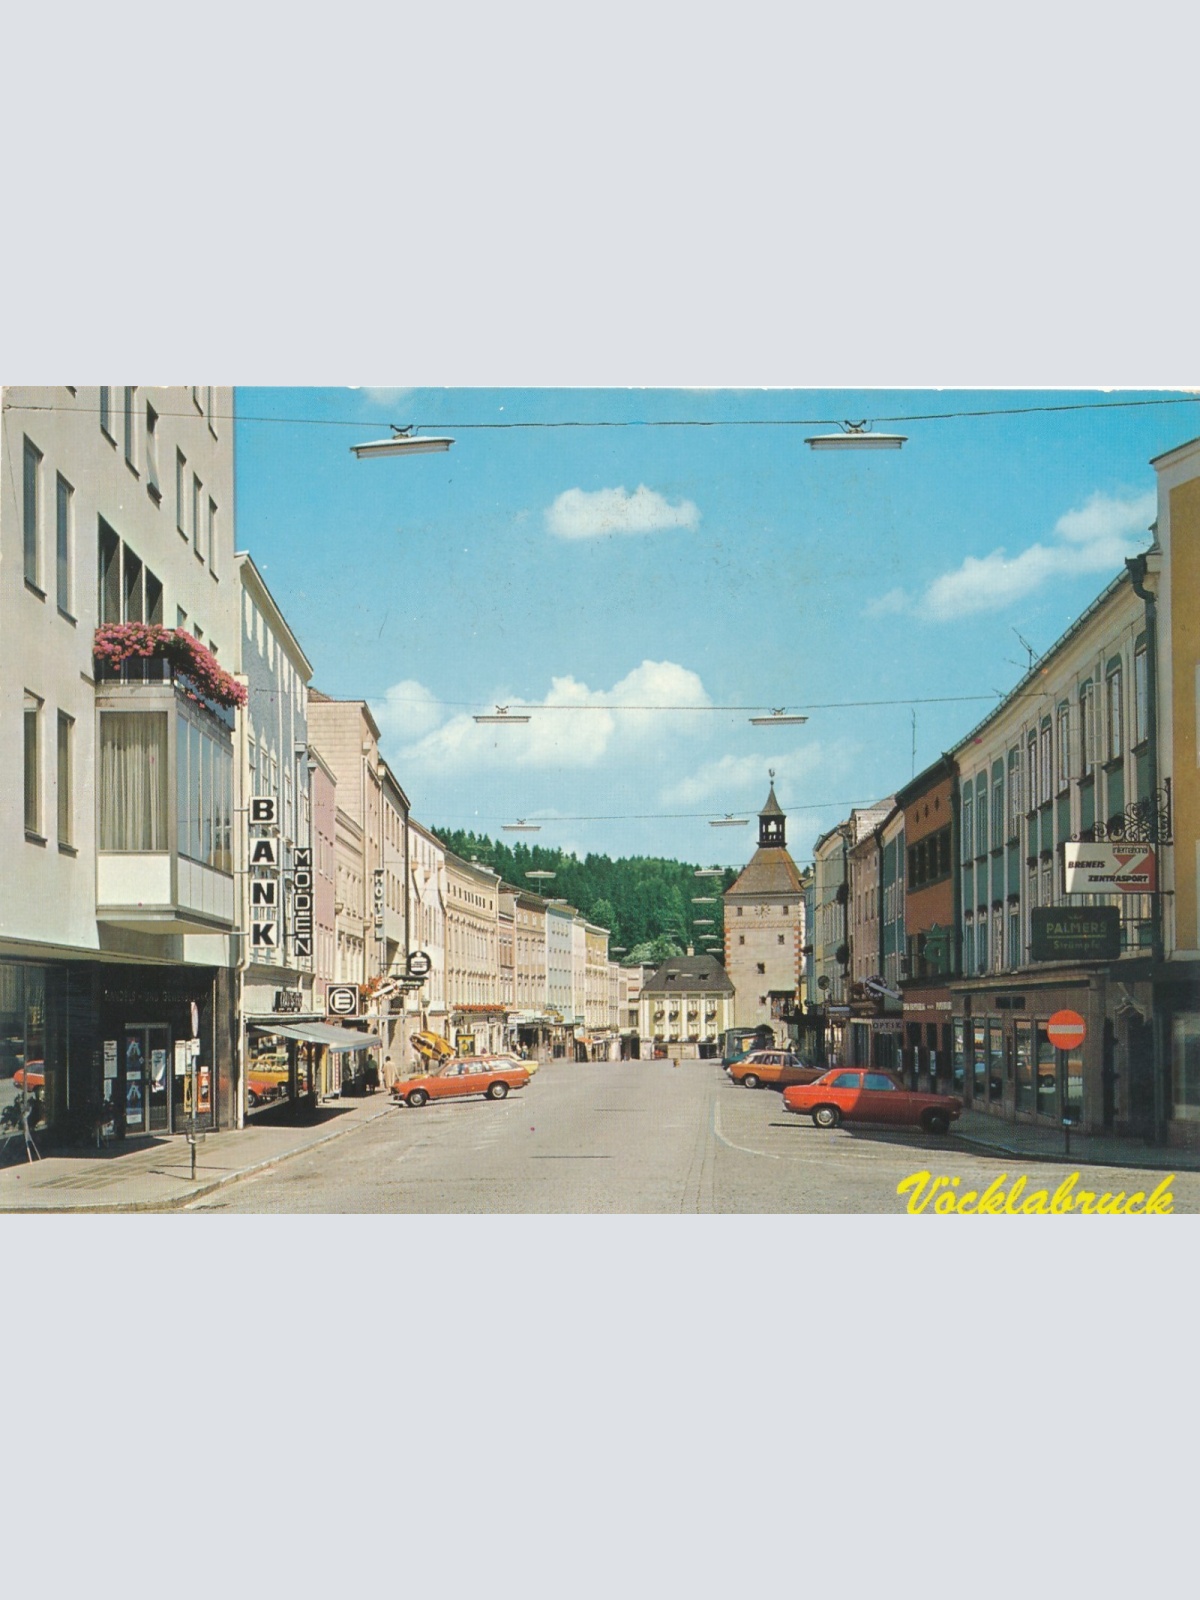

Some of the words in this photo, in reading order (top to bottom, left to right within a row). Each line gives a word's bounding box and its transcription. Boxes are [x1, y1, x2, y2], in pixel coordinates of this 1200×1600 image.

[252, 799, 275, 945] BANK
[1067, 861, 1105, 869] BRENEIS
[294, 849, 311, 955] MODEN
[1046, 921, 1107, 934] PALMERS
